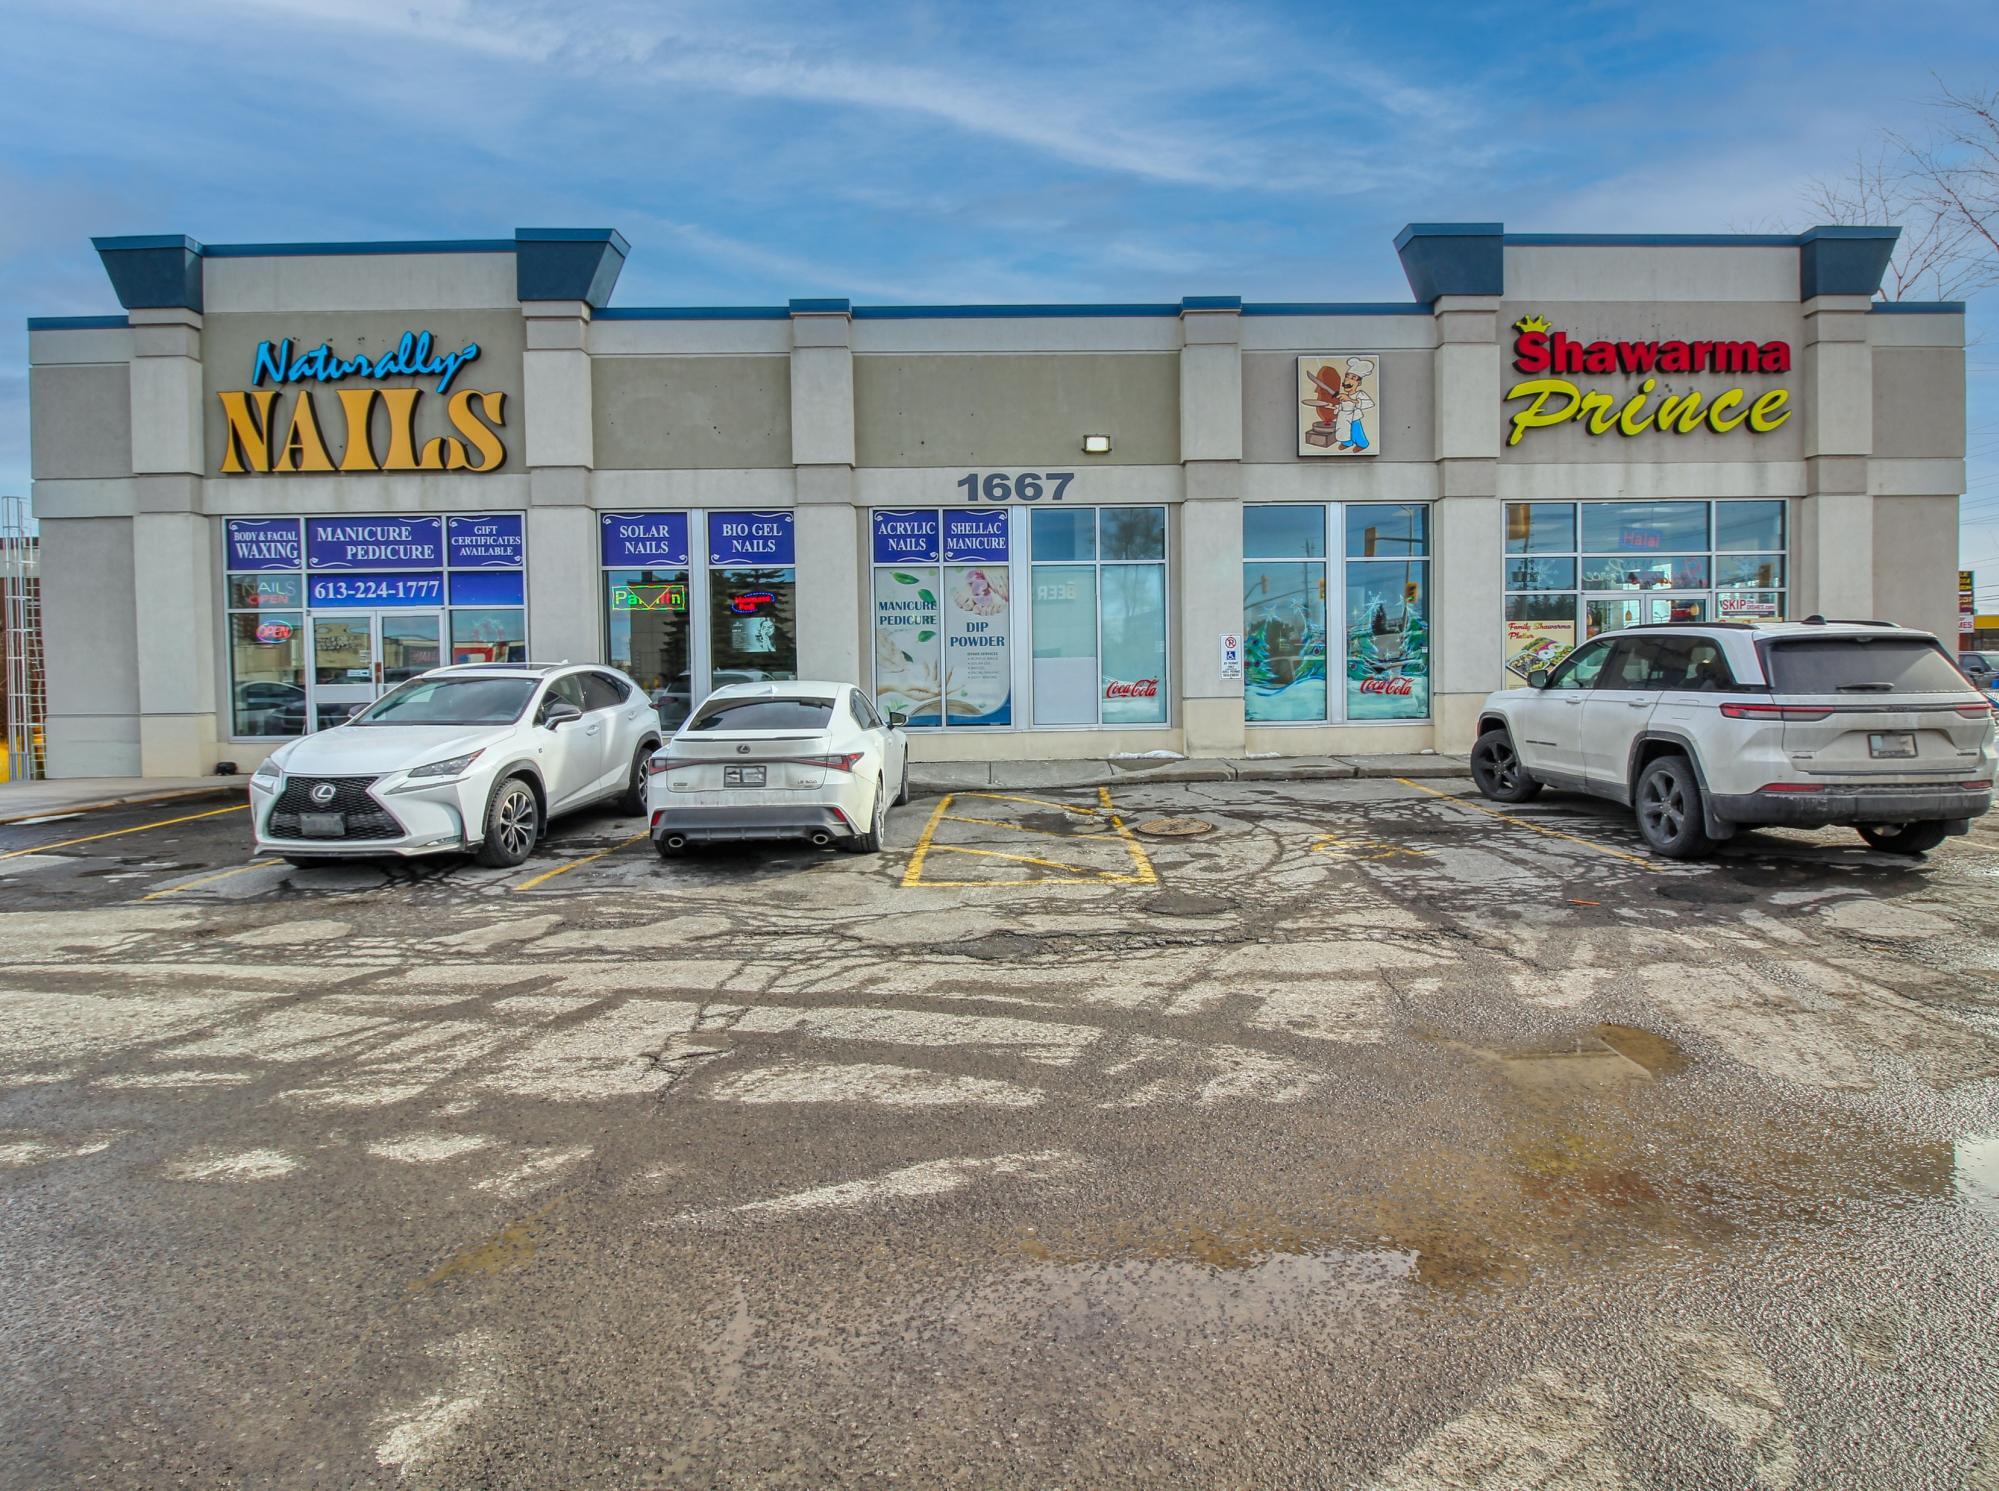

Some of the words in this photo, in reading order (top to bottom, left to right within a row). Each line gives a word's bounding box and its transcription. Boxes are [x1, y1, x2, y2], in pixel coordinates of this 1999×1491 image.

[1514, 331, 1792, 374] Shawarma
[252, 330, 481, 394] Naturally
[1503, 378, 1793, 447] Prince
[216, 388, 508, 473] NAILS
[957, 472, 1075, 502] 1667
[317, 526, 412, 542] MANICURE
[474, 525, 498, 535] GIFT
[619, 525, 670, 538] SOLAR
[722, 523, 748, 536] BIO
[752, 523, 782, 536] GEL
[878, 521, 936, 536] ACRYLIC
[950, 521, 1002, 535] SHELLAC
[234, 531, 258, 542] BODY
[259, 532, 266, 541] &
[267, 531, 298, 541] FACIAL
[451, 536, 521, 546] CERTIFICATES
[625, 541, 669, 554] NAILS
[732, 540, 776, 552] NAILS
[888, 538, 927, 551] NAILS
[947, 537, 1006, 550] MANICURE
[235, 542, 299, 560] WAXING
[346, 545, 435, 560] PEDICURE
[459, 546, 514, 556] AVAILABLE
[241, 581, 297, 596] NAILS
[314, 581, 440, 599] 613-224-1777
[879, 601, 937, 612] MANICURE
[1722, 599, 1746, 610] SKIP
[879, 615, 937, 625] PEDICURE
[257, 624, 290, 639] OPEN
[966, 621, 989, 633] DIP
[950, 635, 1005, 647] POWDER
